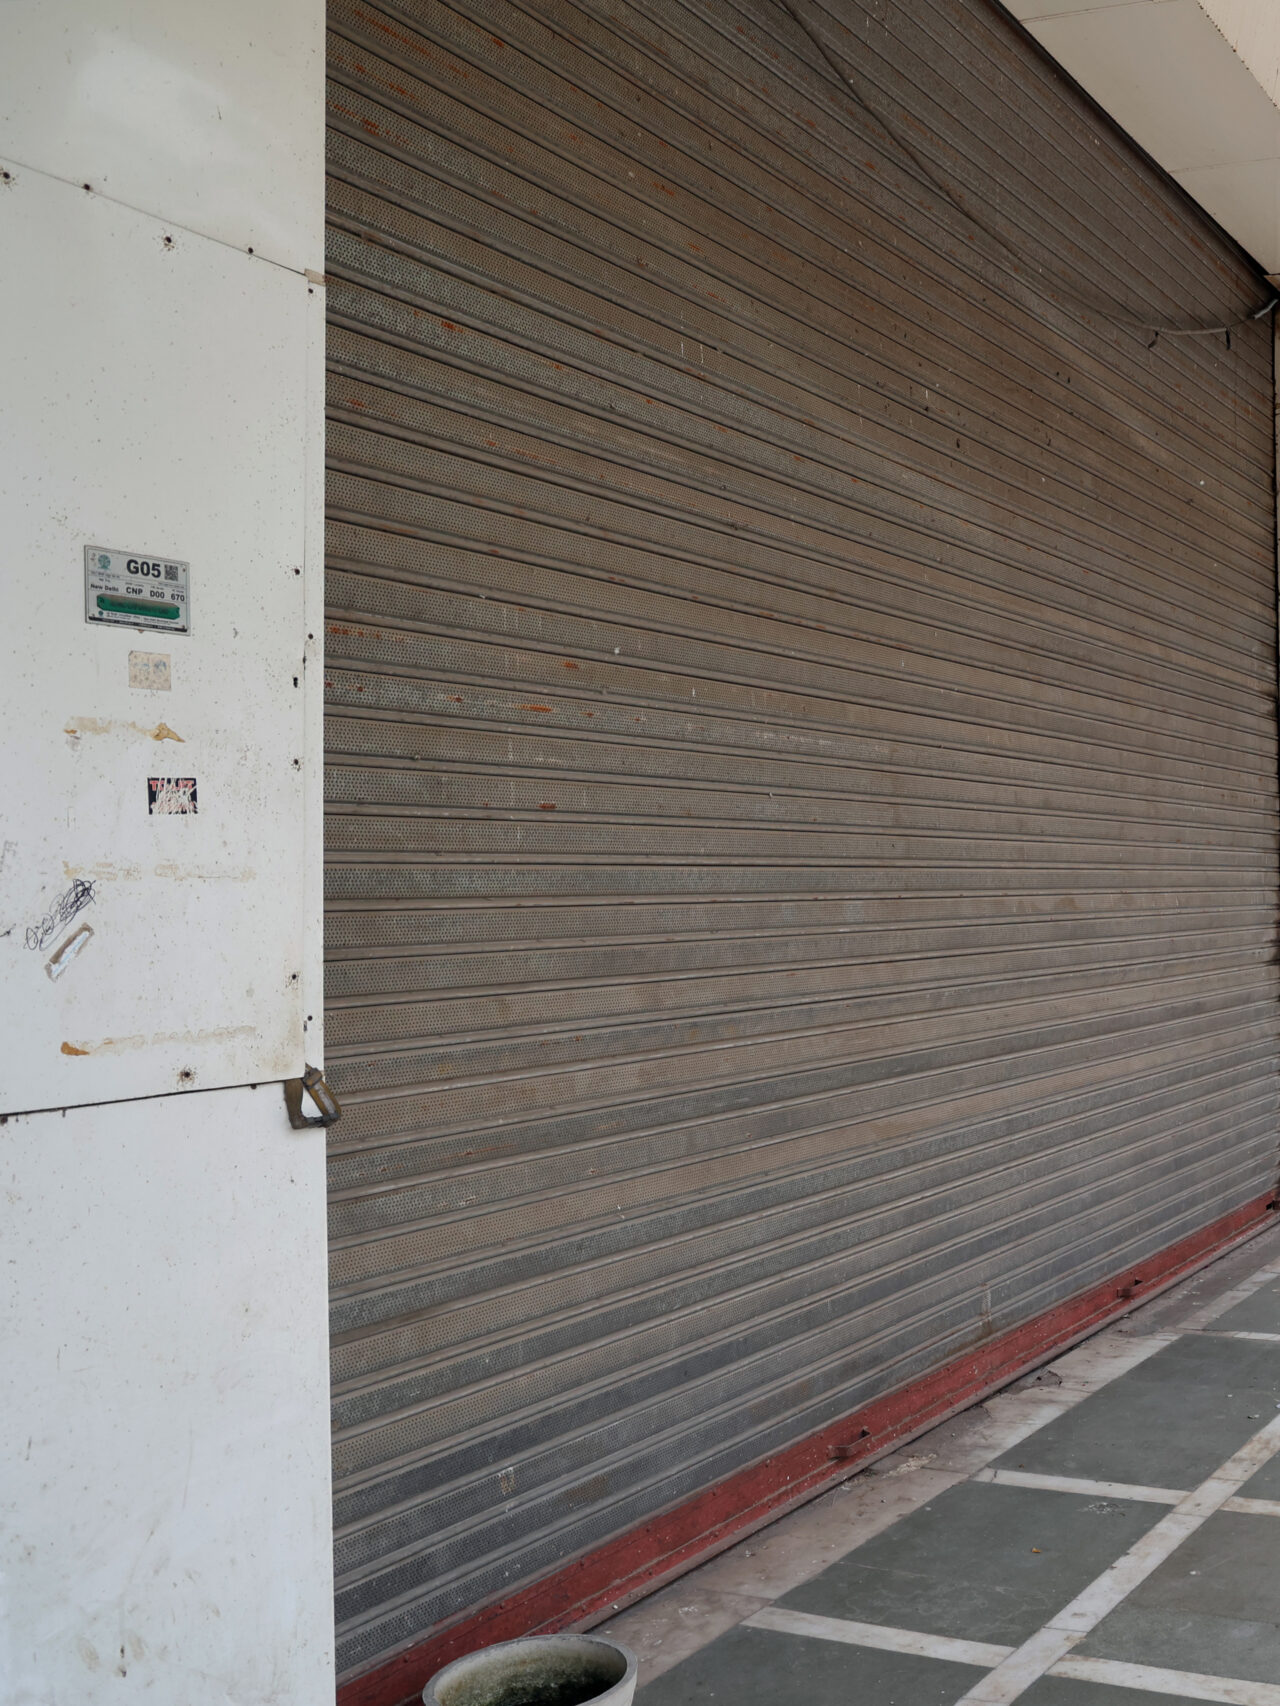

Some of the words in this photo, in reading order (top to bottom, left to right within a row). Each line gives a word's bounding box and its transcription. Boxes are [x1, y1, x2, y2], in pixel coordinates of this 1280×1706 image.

[126, 559, 161, 578] G05
[90, 583, 103, 591] New
[126, 587, 143, 595] CNP
[171, 593, 185, 602] 670
